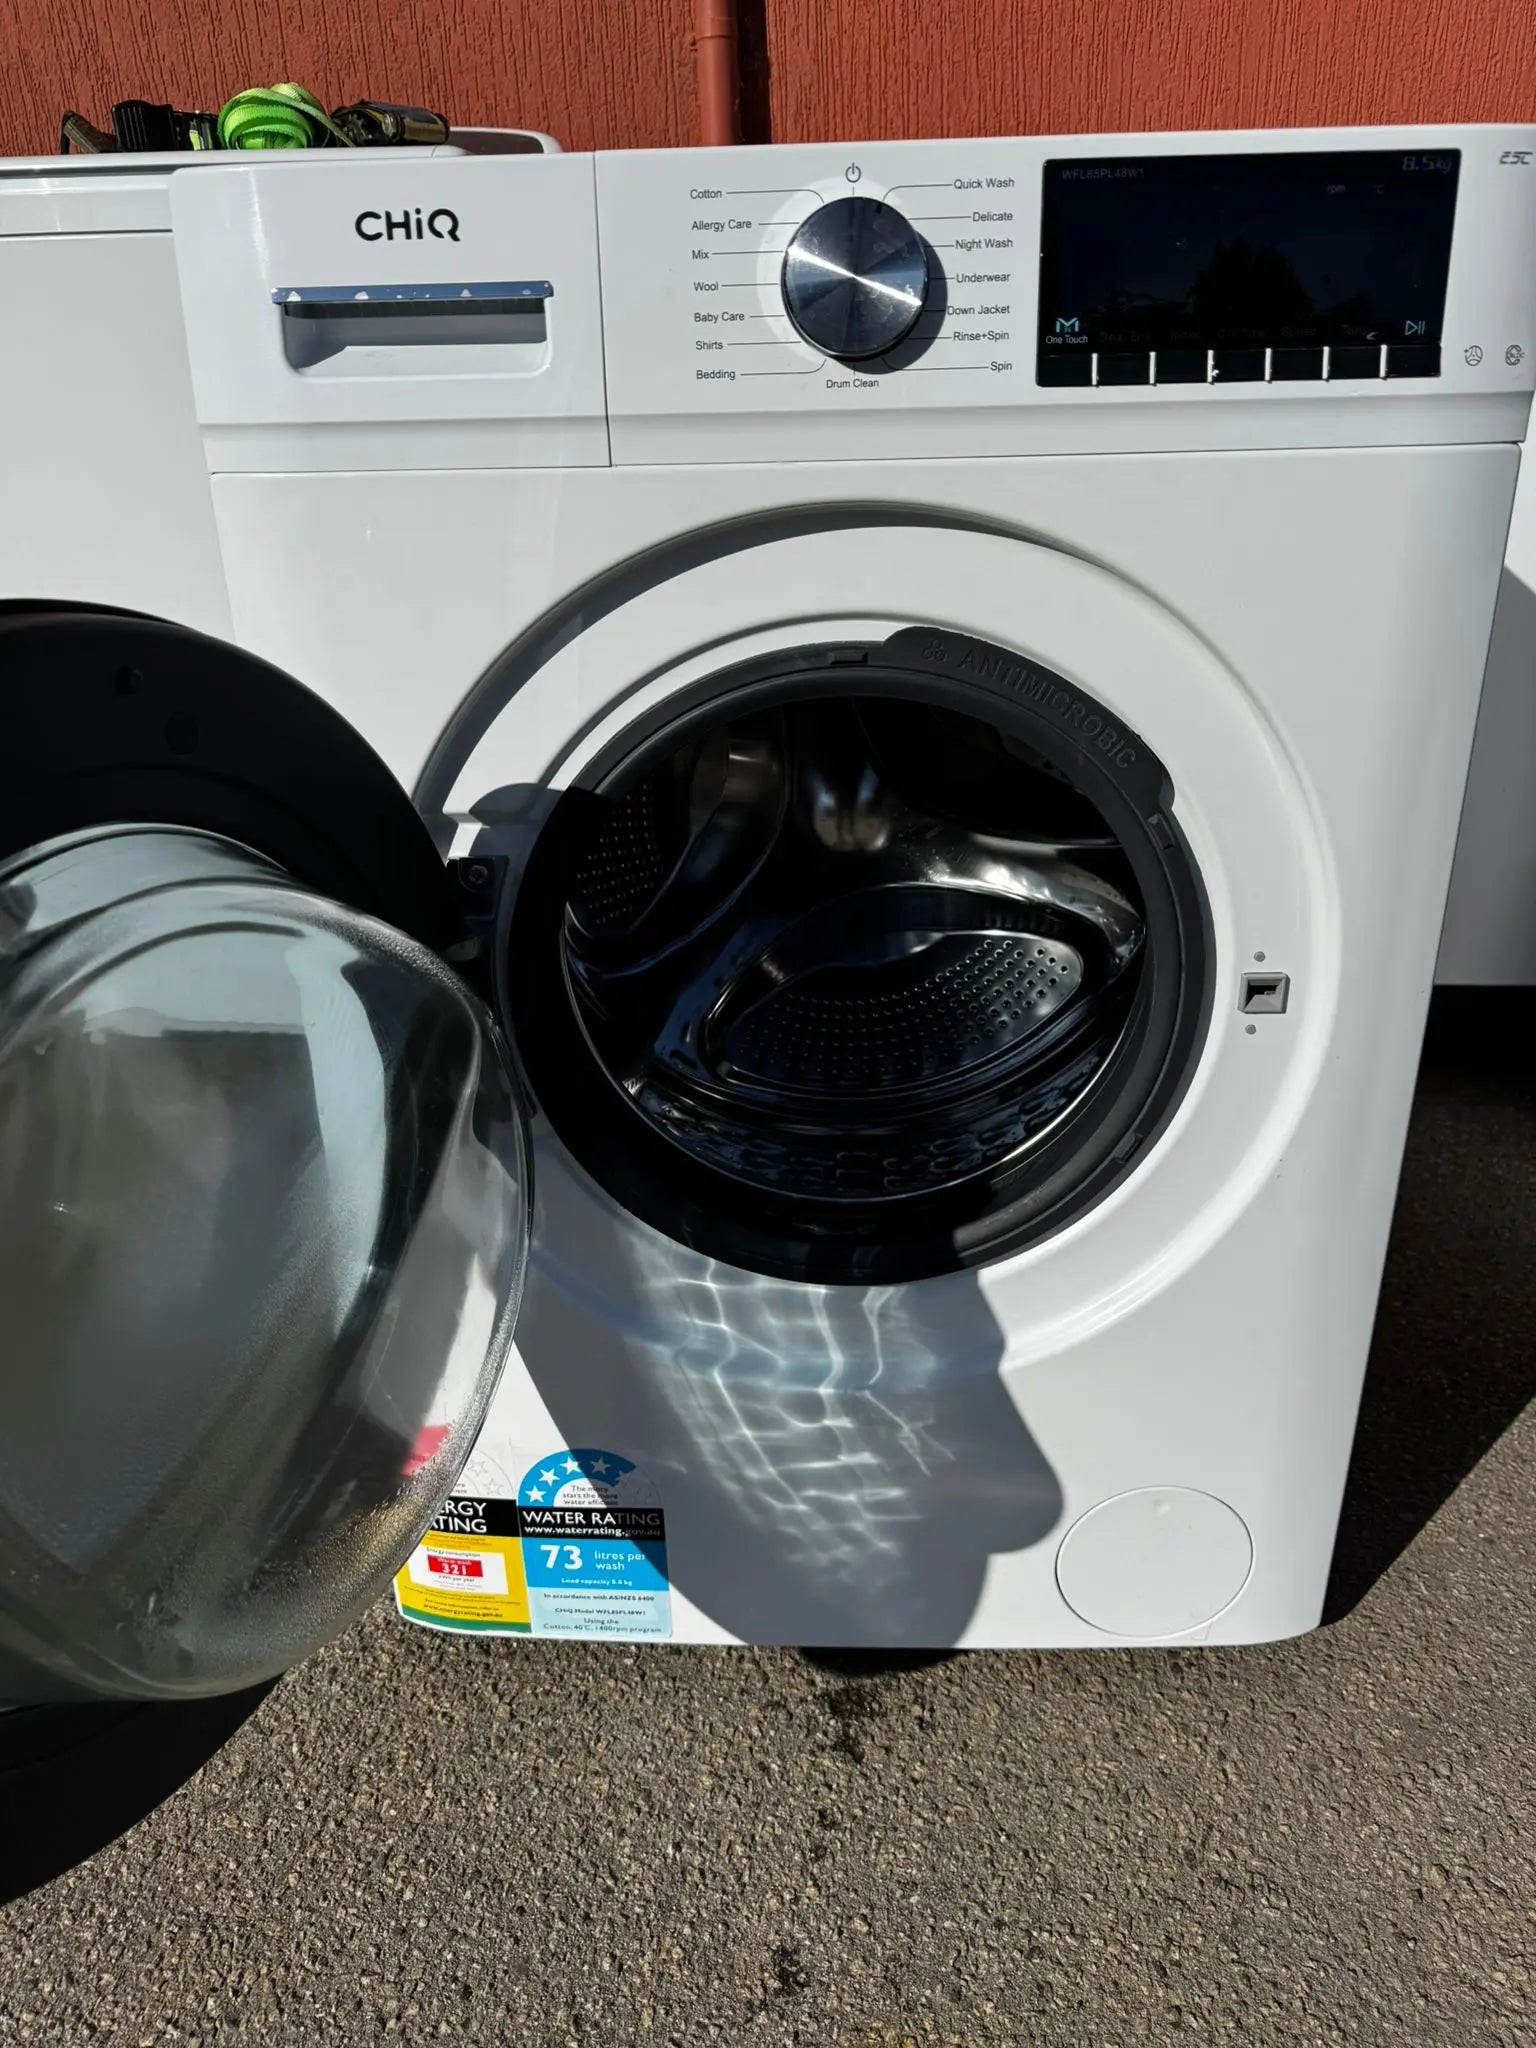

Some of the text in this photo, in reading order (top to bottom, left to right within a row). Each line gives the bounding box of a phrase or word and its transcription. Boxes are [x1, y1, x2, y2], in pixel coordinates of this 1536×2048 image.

[953, 177, 1015, 190] Quick Wash
[690, 188, 722, 200] Cotton
[972, 211, 1013, 222] Delicate
[355, 207, 461, 243] CHiQ
[691, 219, 752, 233] Allergy Care
[955, 238, 1013, 251] Night Wash
[692, 250, 709, 260] Mix
[956, 272, 1011, 283] Underwear
[693, 281, 719, 292] Wool
[947, 304, 1011, 316] Down Jacket
[694, 311, 745, 324] Baby Care
[953, 331, 1010, 345] Rinse+Spin
[1045, 335, 1063, 345] One
[1064, 334, 1089, 344] Touch
[695, 340, 724, 350] Shirts
[990, 361, 1013, 373] Spin
[696, 369, 736, 381] Bedding
[826, 378, 879, 389] Drum Clean
[957, 648, 1137, 769] ANTIMICROBIC
[440, 1500, 487, 1517] RGY
[432, 1515, 487, 1533] TING
[522, 1510, 660, 1526] WATER RATING
[523, 1526, 661, 1537] www.waterrating.gov.au
[539, 1544, 583, 1570] 73
[594, 1550, 625, 1560] litres
[441, 1563, 467, 1575] 321
[595, 1560, 625, 1570] wash
[584, 1617, 606, 1625] Using
